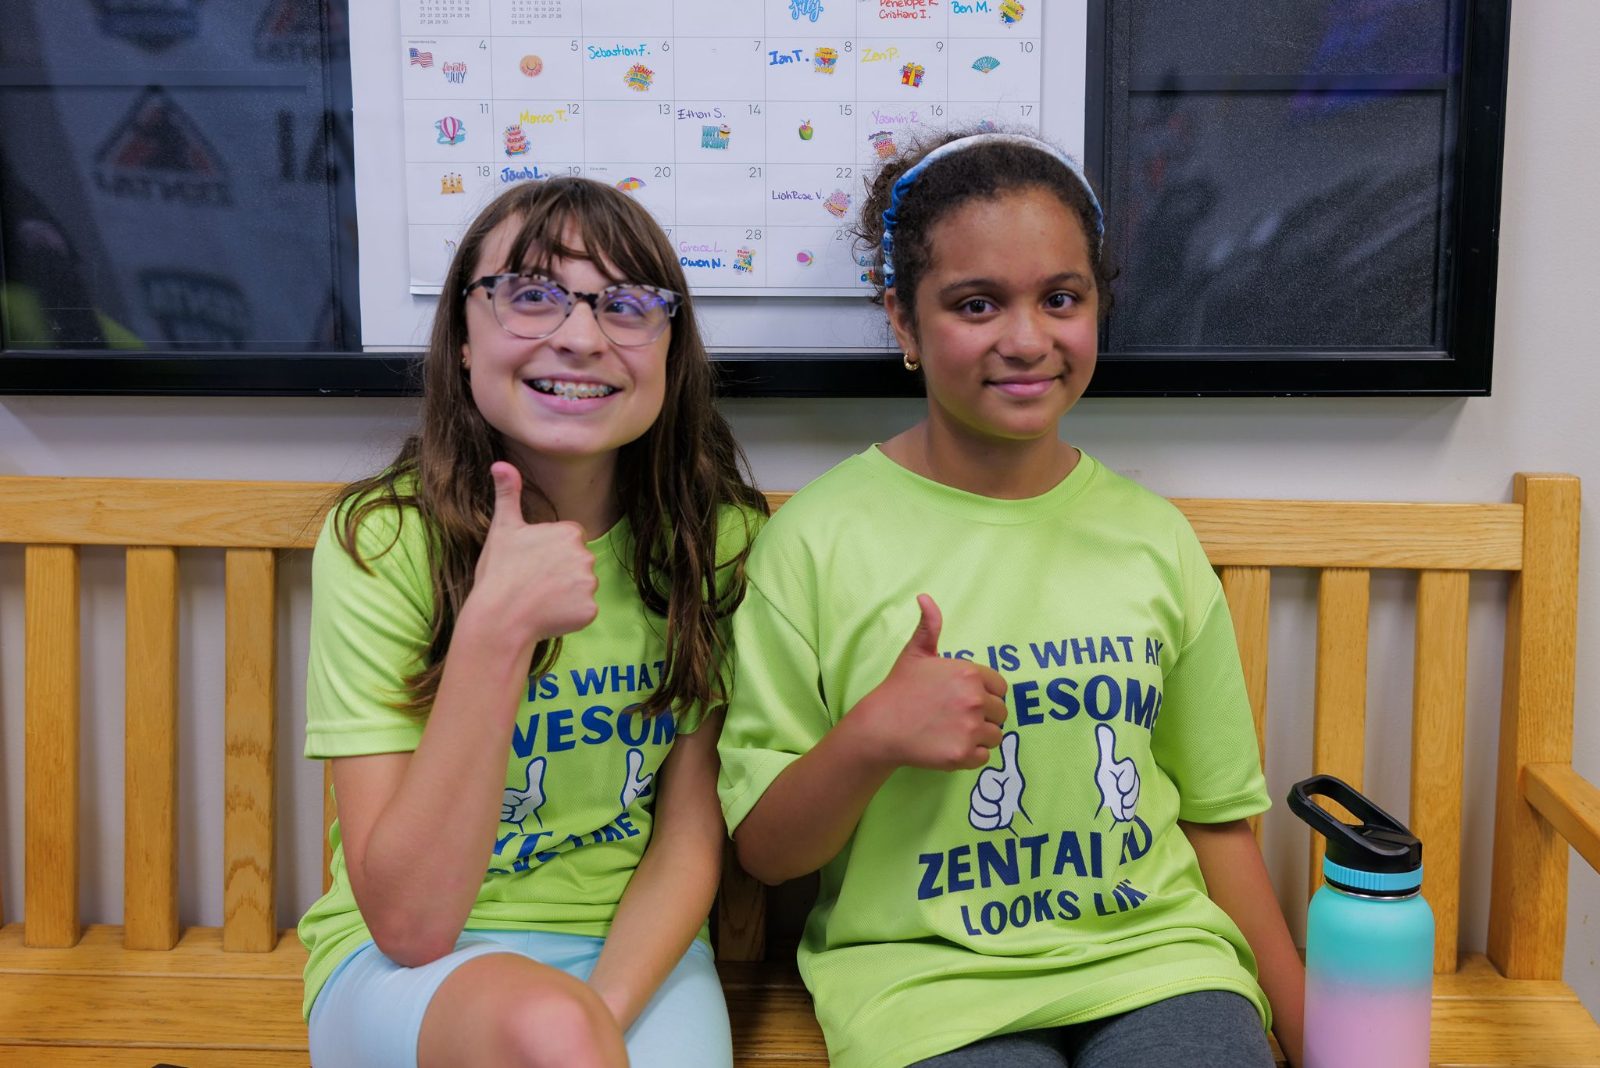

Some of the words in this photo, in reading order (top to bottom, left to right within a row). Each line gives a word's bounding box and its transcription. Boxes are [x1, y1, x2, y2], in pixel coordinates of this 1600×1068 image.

[976, 1, 992, 13] M.
[479, 40, 487, 50] 4
[571, 40, 579, 51] 5
[662, 41, 670, 52] 6
[753, 41, 761, 51] 7
[844, 41, 853, 52] 8
[936, 41, 944, 52] 9
[1019, 41, 1034, 53] 10
[768, 50, 793, 66] Ian
[792, 49, 810, 62] T.
[479, 103, 489, 114] 11
[567, 103, 580, 115] 12
[658, 104, 671, 115] 13
[677, 108, 711, 120] Ethan
[713, 107, 726, 119] S.
[748, 104, 761, 115] 14
[839, 104, 853, 116] 15
[930, 105, 944, 116] 16
[1020, 105, 1033, 117] 17
[520, 108, 554, 126] Marco
[555, 109, 568, 122] T.
[872, 110, 908, 125] Yasmin
[477, 165, 490, 177] 18
[500, 166, 534, 183] Jacob
[533, 166, 548, 179] L.
[568, 166, 581, 177] 19
[654, 166, 671, 178] 20
[749, 167, 762, 178] 21
[836, 167, 852, 179] 22
[745, 229, 762, 240] 28
[835, 229, 852, 241] 29
[679, 241, 712, 253] Grace
[680, 256, 710, 268] Owen
[732, 263, 748, 273] DAY!
[987, 643, 1021, 673] IS
[1028, 635, 1134, 669] WHAT
[528, 673, 560, 702] IS
[917, 831, 1103, 900] ZENTAI
[960, 889, 1082, 936] LOOKS
[1093, 879, 1149, 916] LIK
